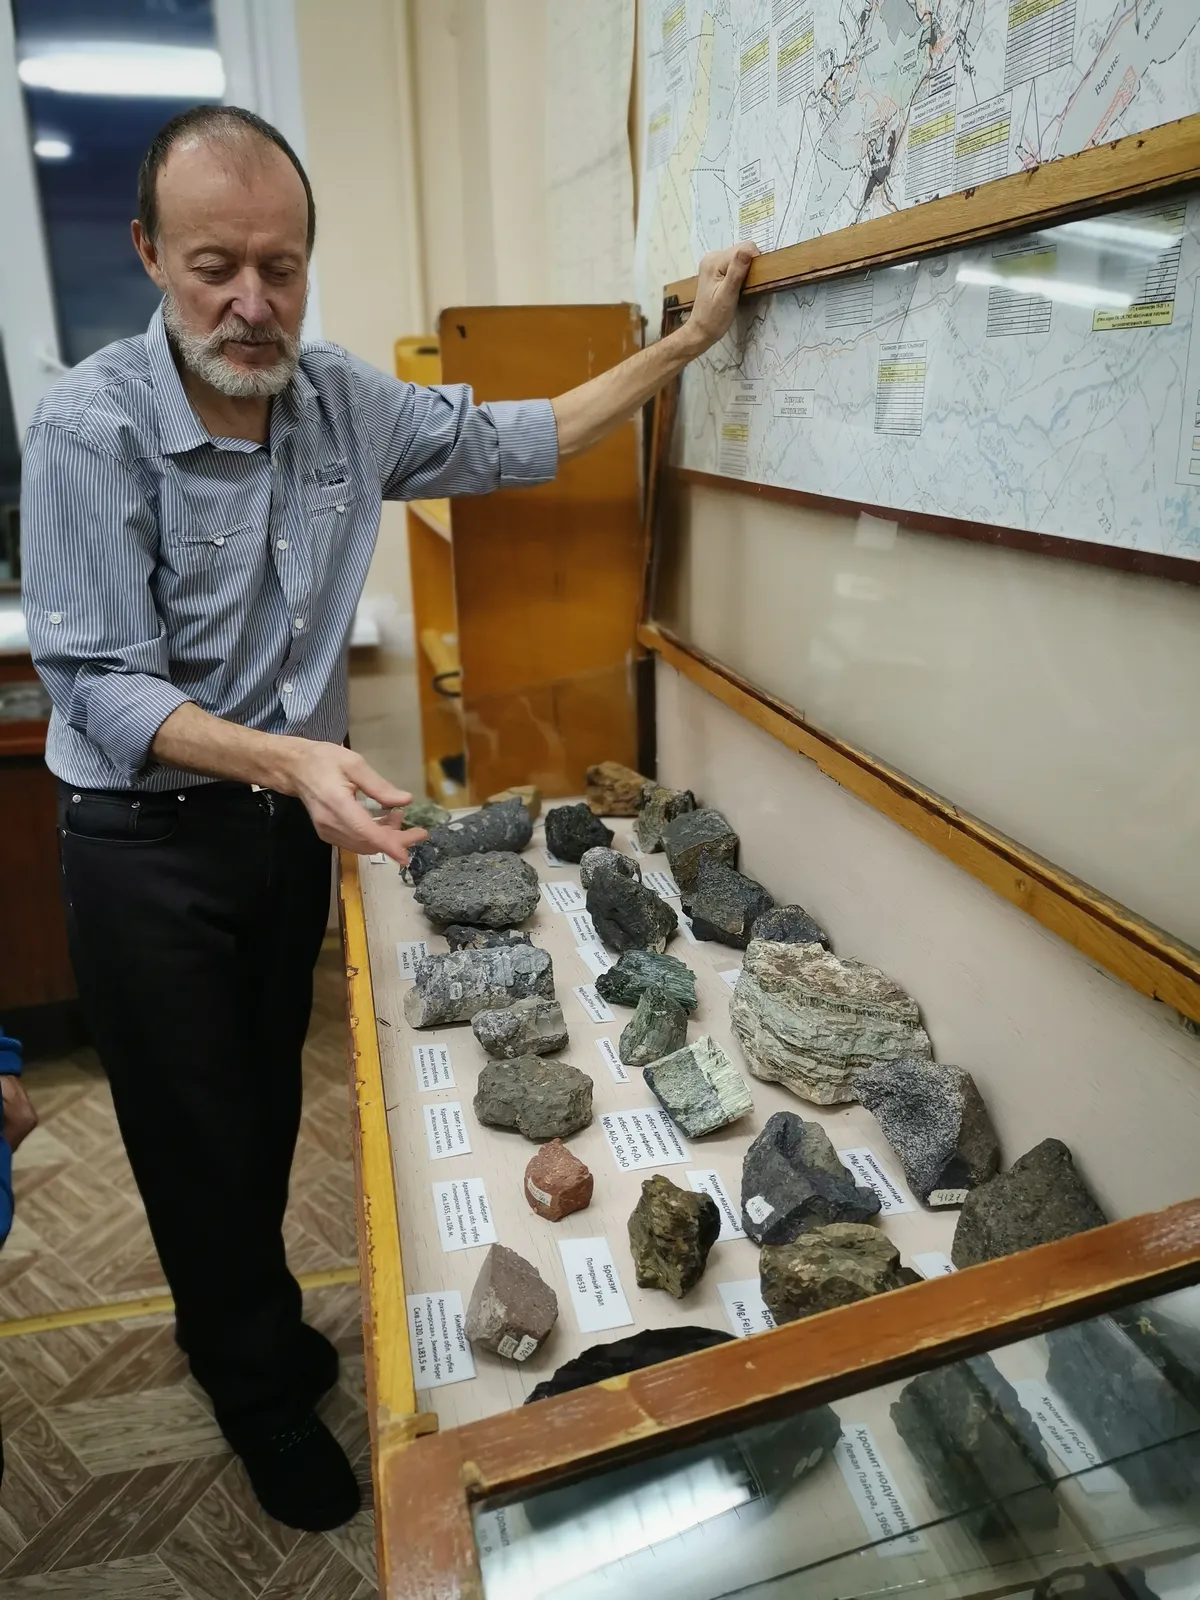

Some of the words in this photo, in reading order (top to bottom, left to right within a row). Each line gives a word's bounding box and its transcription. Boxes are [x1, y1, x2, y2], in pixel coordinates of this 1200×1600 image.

[462, 1181, 474, 1214] Архангельская
[478, 1195, 489, 1223] Кимберлит
[709, 1174, 724, 1196] Хромит
[720, 1197, 742, 1232] массивный
[576, 1274, 587, 1293] №533
[586, 1257, 601, 1289] Полярный
[594, 1290, 605, 1306] Урал
[603, 1264, 618, 1294] Бронзит
[437, 1299, 449, 1339] Архангельская
[454, 1314, 467, 1352] Кимберлит
[430, 1340, 440, 1363] Зимний
[444, 1340, 452, 1352] обл.
[433, 1363, 441, 1380] берег
[445, 1353, 455, 1373] трубка
[856, 1429, 880, 1468] Хромит
[842, 1442, 860, 1470] Левая
[857, 1471, 878, 1509] Пайера,
